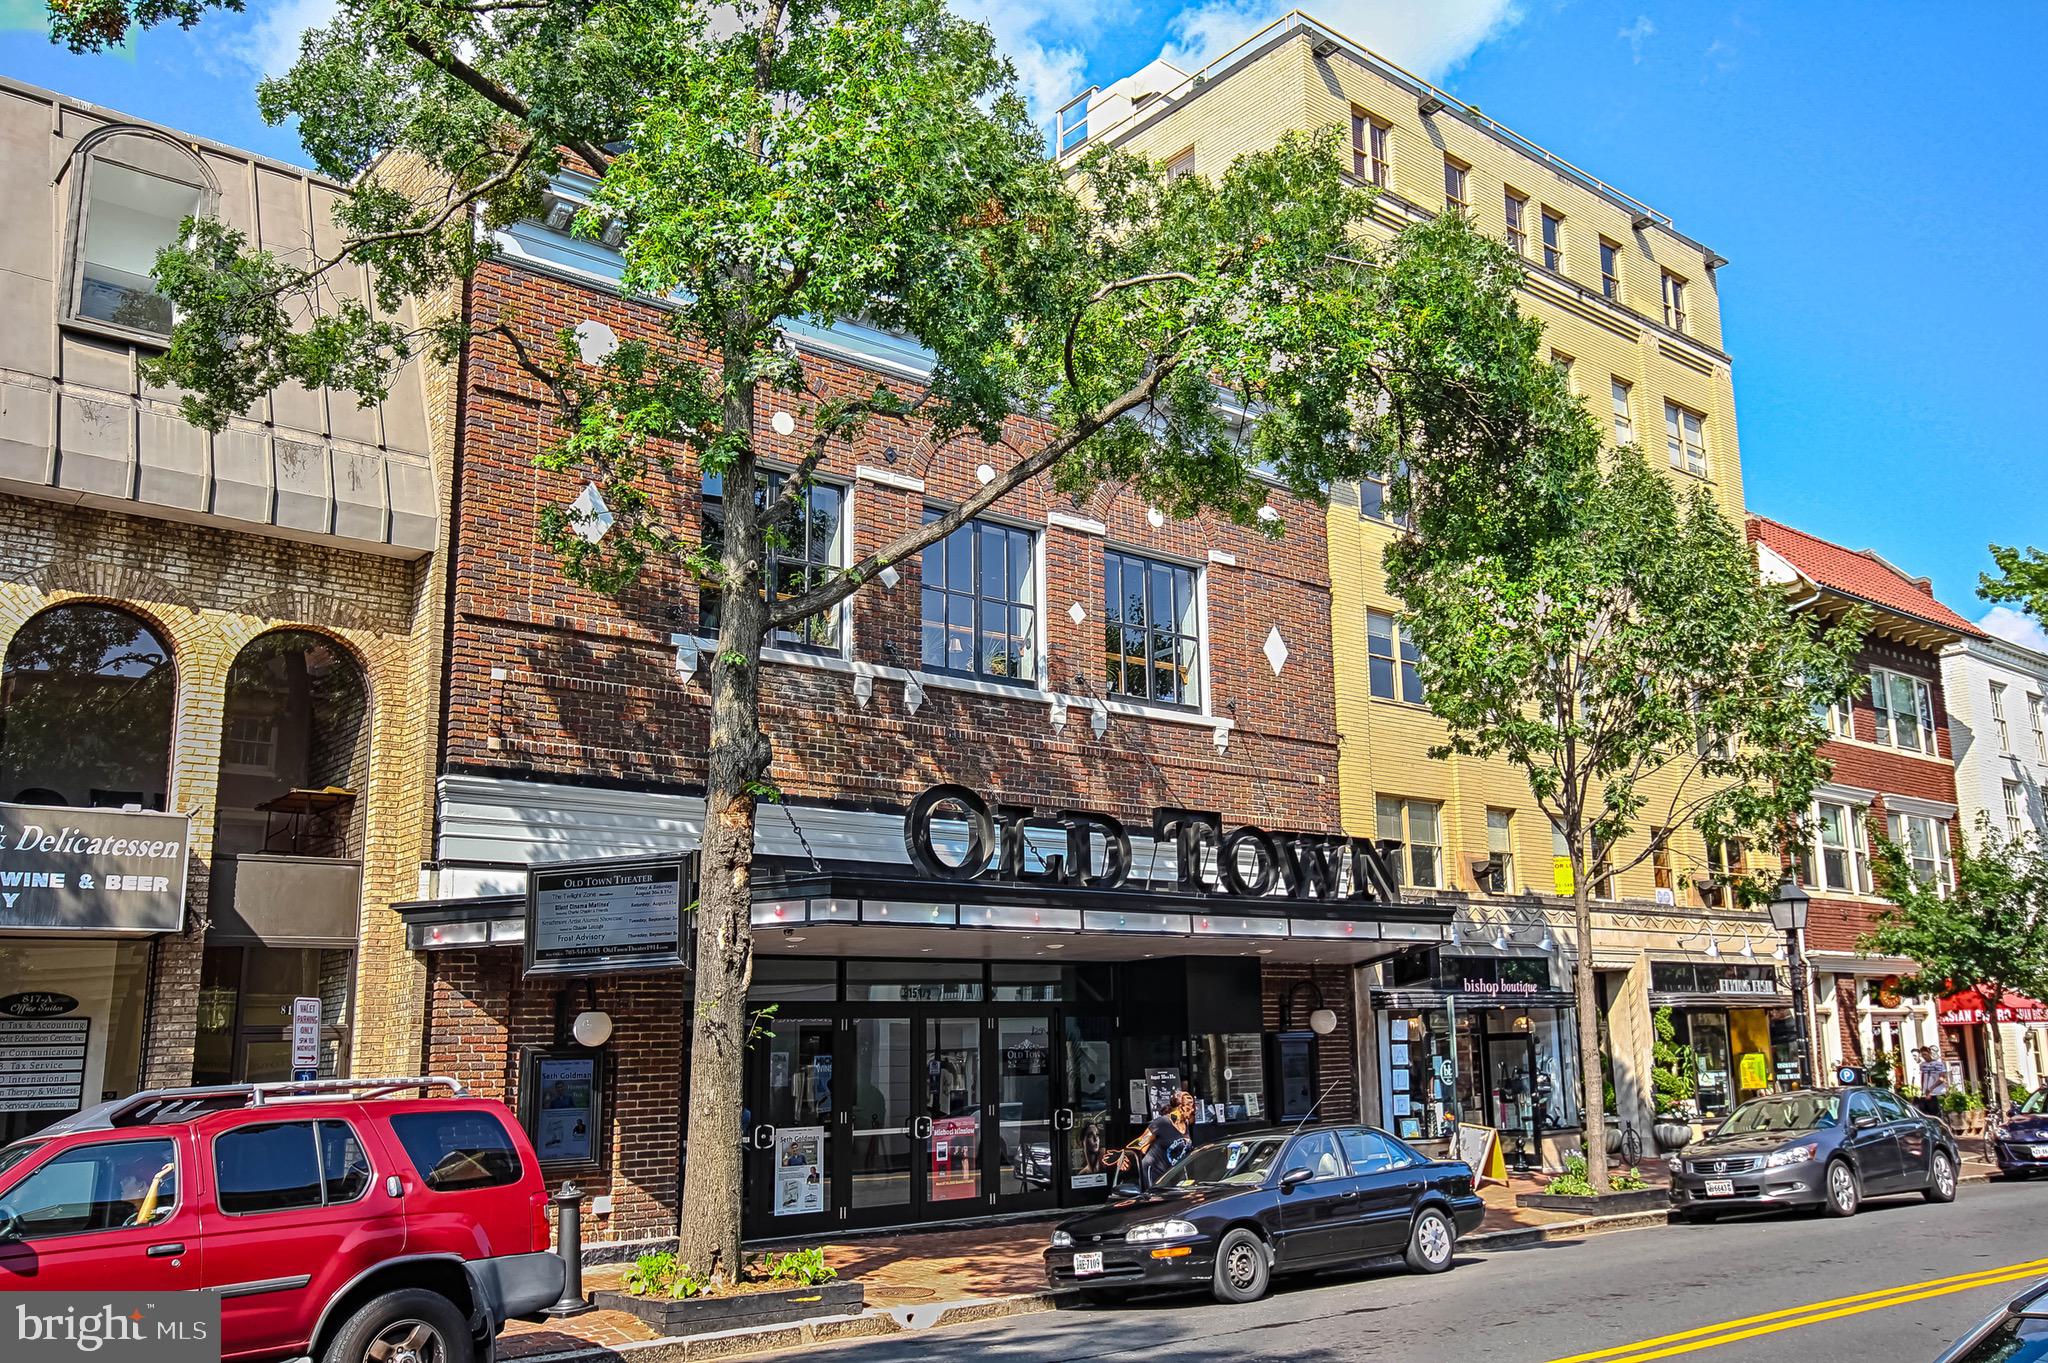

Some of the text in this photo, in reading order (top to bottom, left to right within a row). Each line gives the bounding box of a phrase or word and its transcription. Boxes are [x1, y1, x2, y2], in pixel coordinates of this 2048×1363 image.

[15, 825, 179, 858] Delicatessen
[904, 783, 1404, 906] OLD TOWN
[1, 872, 169, 892] WINE & BEER
[564, 874, 653, 888] OLD TOWN THEATER
[557, 933, 605, 942] Frost Advisory
[1463, 977, 1538, 997] bishop boutique
[11, 1003, 63, 1015] Office Suites
[300, 1004, 316, 1013] VALET
[36, 1021, 86, 1030] Accounting
[300, 1026, 313, 1035] ONLY
[9, 1047, 78, 1057] Communication
[10, 1062, 26, 1070] Tax
[29, 1061, 63, 1070] Service
[8, 1074, 68, 1083] International
[560, 1071, 592, 1079] Goldman
[7, 1088, 37, 1097] Therapy
[780, 1135, 793, 1143] Seth
